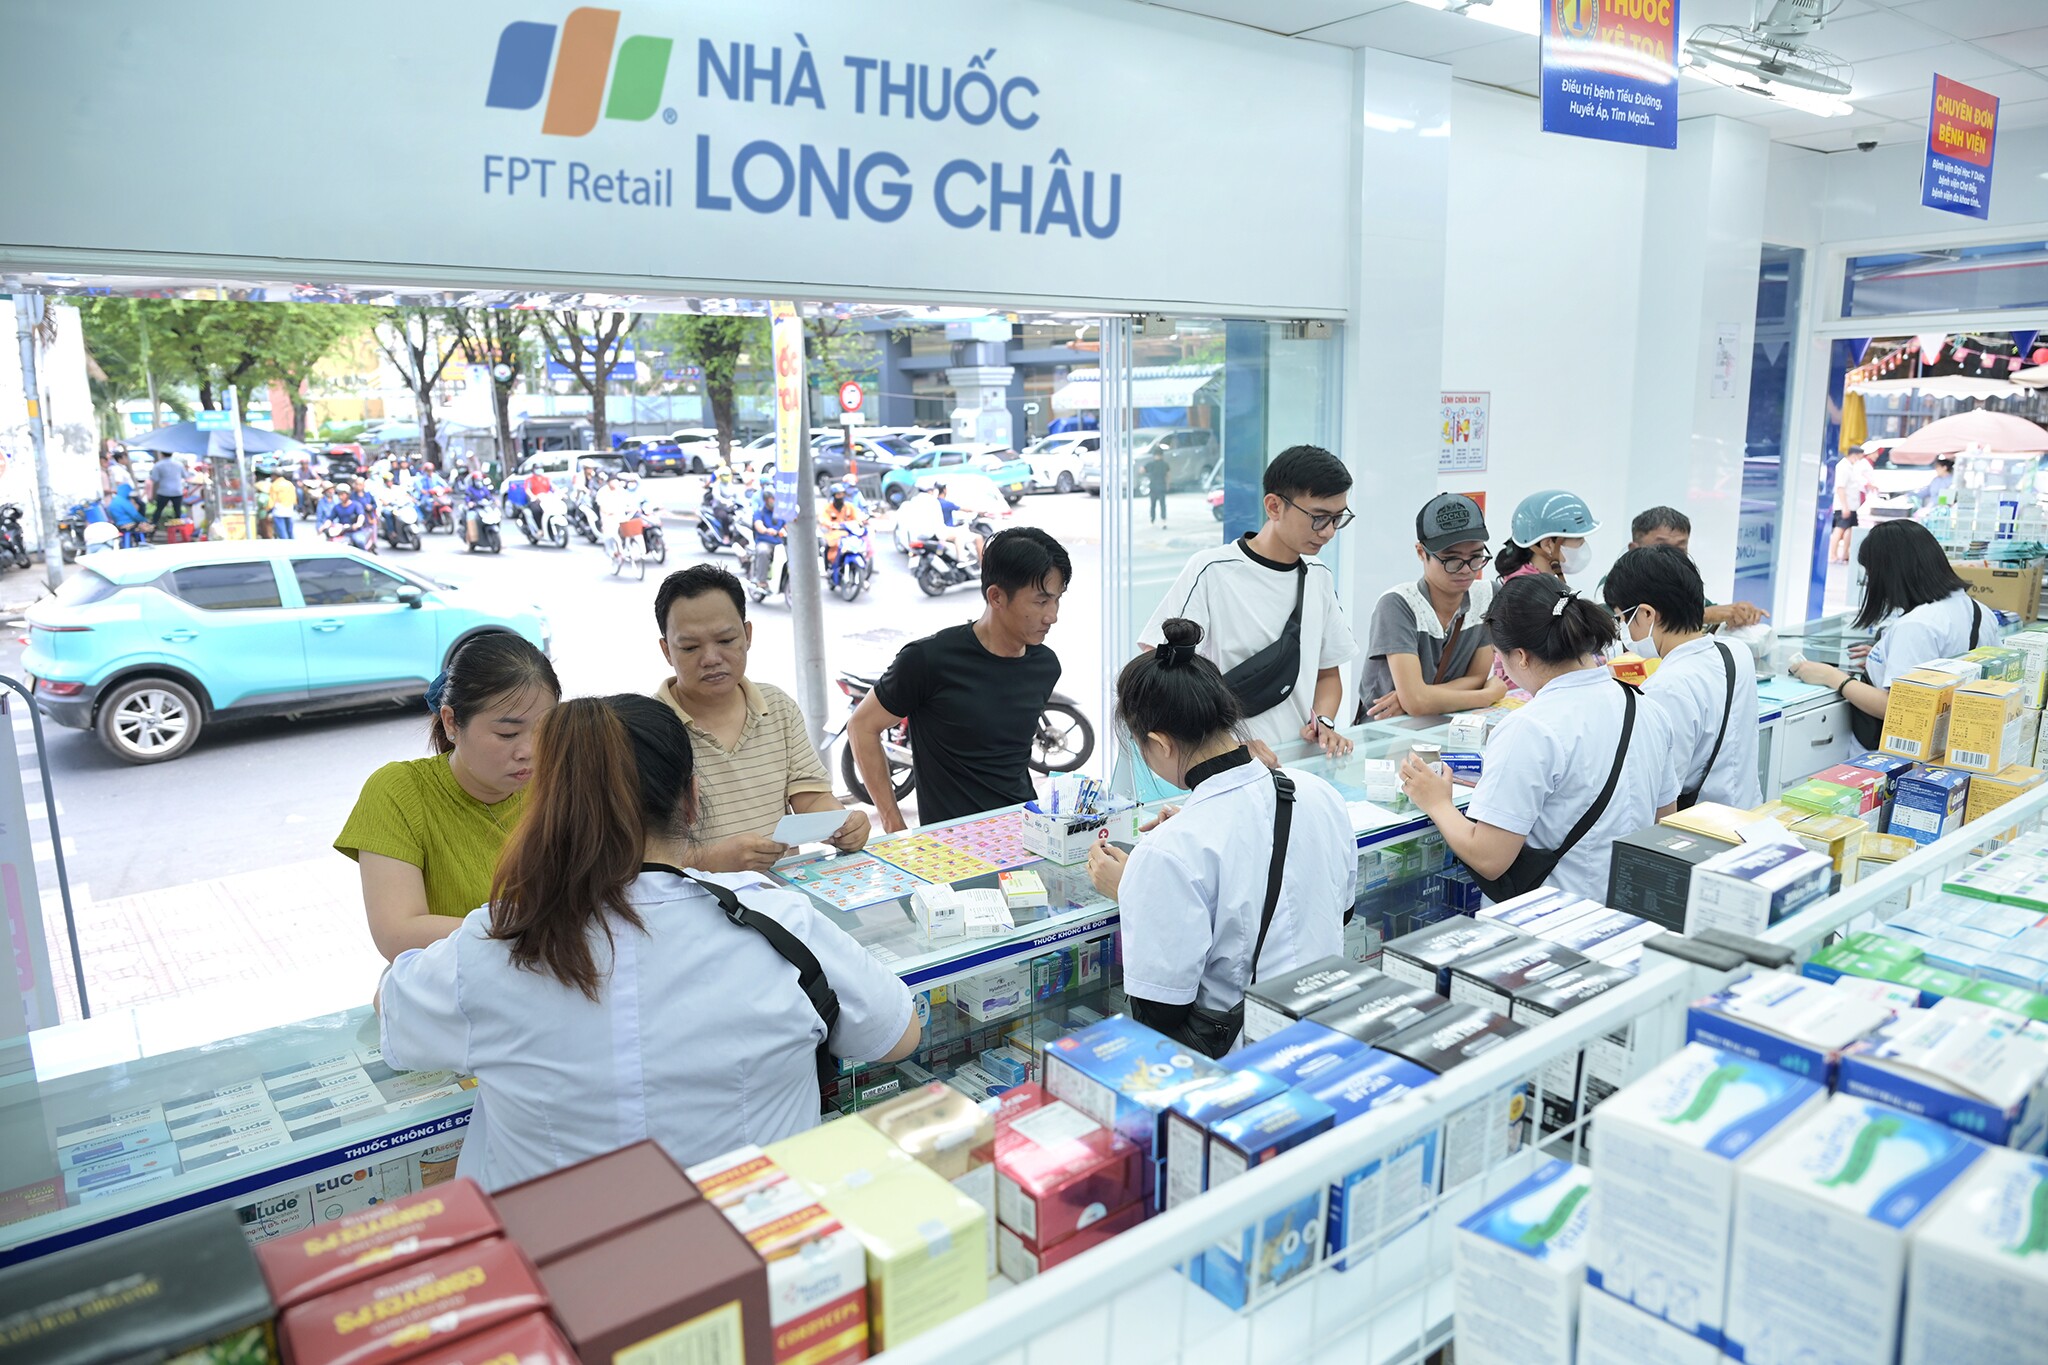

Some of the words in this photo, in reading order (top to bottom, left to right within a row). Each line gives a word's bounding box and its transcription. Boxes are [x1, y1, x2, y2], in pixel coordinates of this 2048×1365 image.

[699, 33, 826, 110] NHÀ
[844, 48, 1040, 131] THUỐC
[1562, 79, 1582, 94] Điều
[1583, 82, 1593, 99] trị
[1594, 85, 1615, 101] bệnh
[1617, 88, 1633, 104] Tiểu
[1635, 92, 1663, 110] Đường,
[1570, 101, 1595, 119] Huyết
[1596, 103, 1609, 121] Áp,
[1611, 107, 1626, 121] Tim
[1936, 94, 1973, 123] CHUYÊN
[1974, 108, 1994, 130] ĐƠN
[1939, 121, 1964, 148] BỆNH
[1966, 131, 1987, 156] VIỆN
[483, 155, 557, 198] FPT
[567, 162, 673, 208] Retail
[696, 133, 914, 223] LONG
[933, 146, 1122, 240] CHÂU
[1437, 511, 1468, 523] HOCKEY
[345, 1139, 388, 1159] THUỐC
[391, 1126, 435, 1145] KHÔNG
[437, 1118, 453, 1131] KÊ
[257, 1199, 298, 1219] Lude
